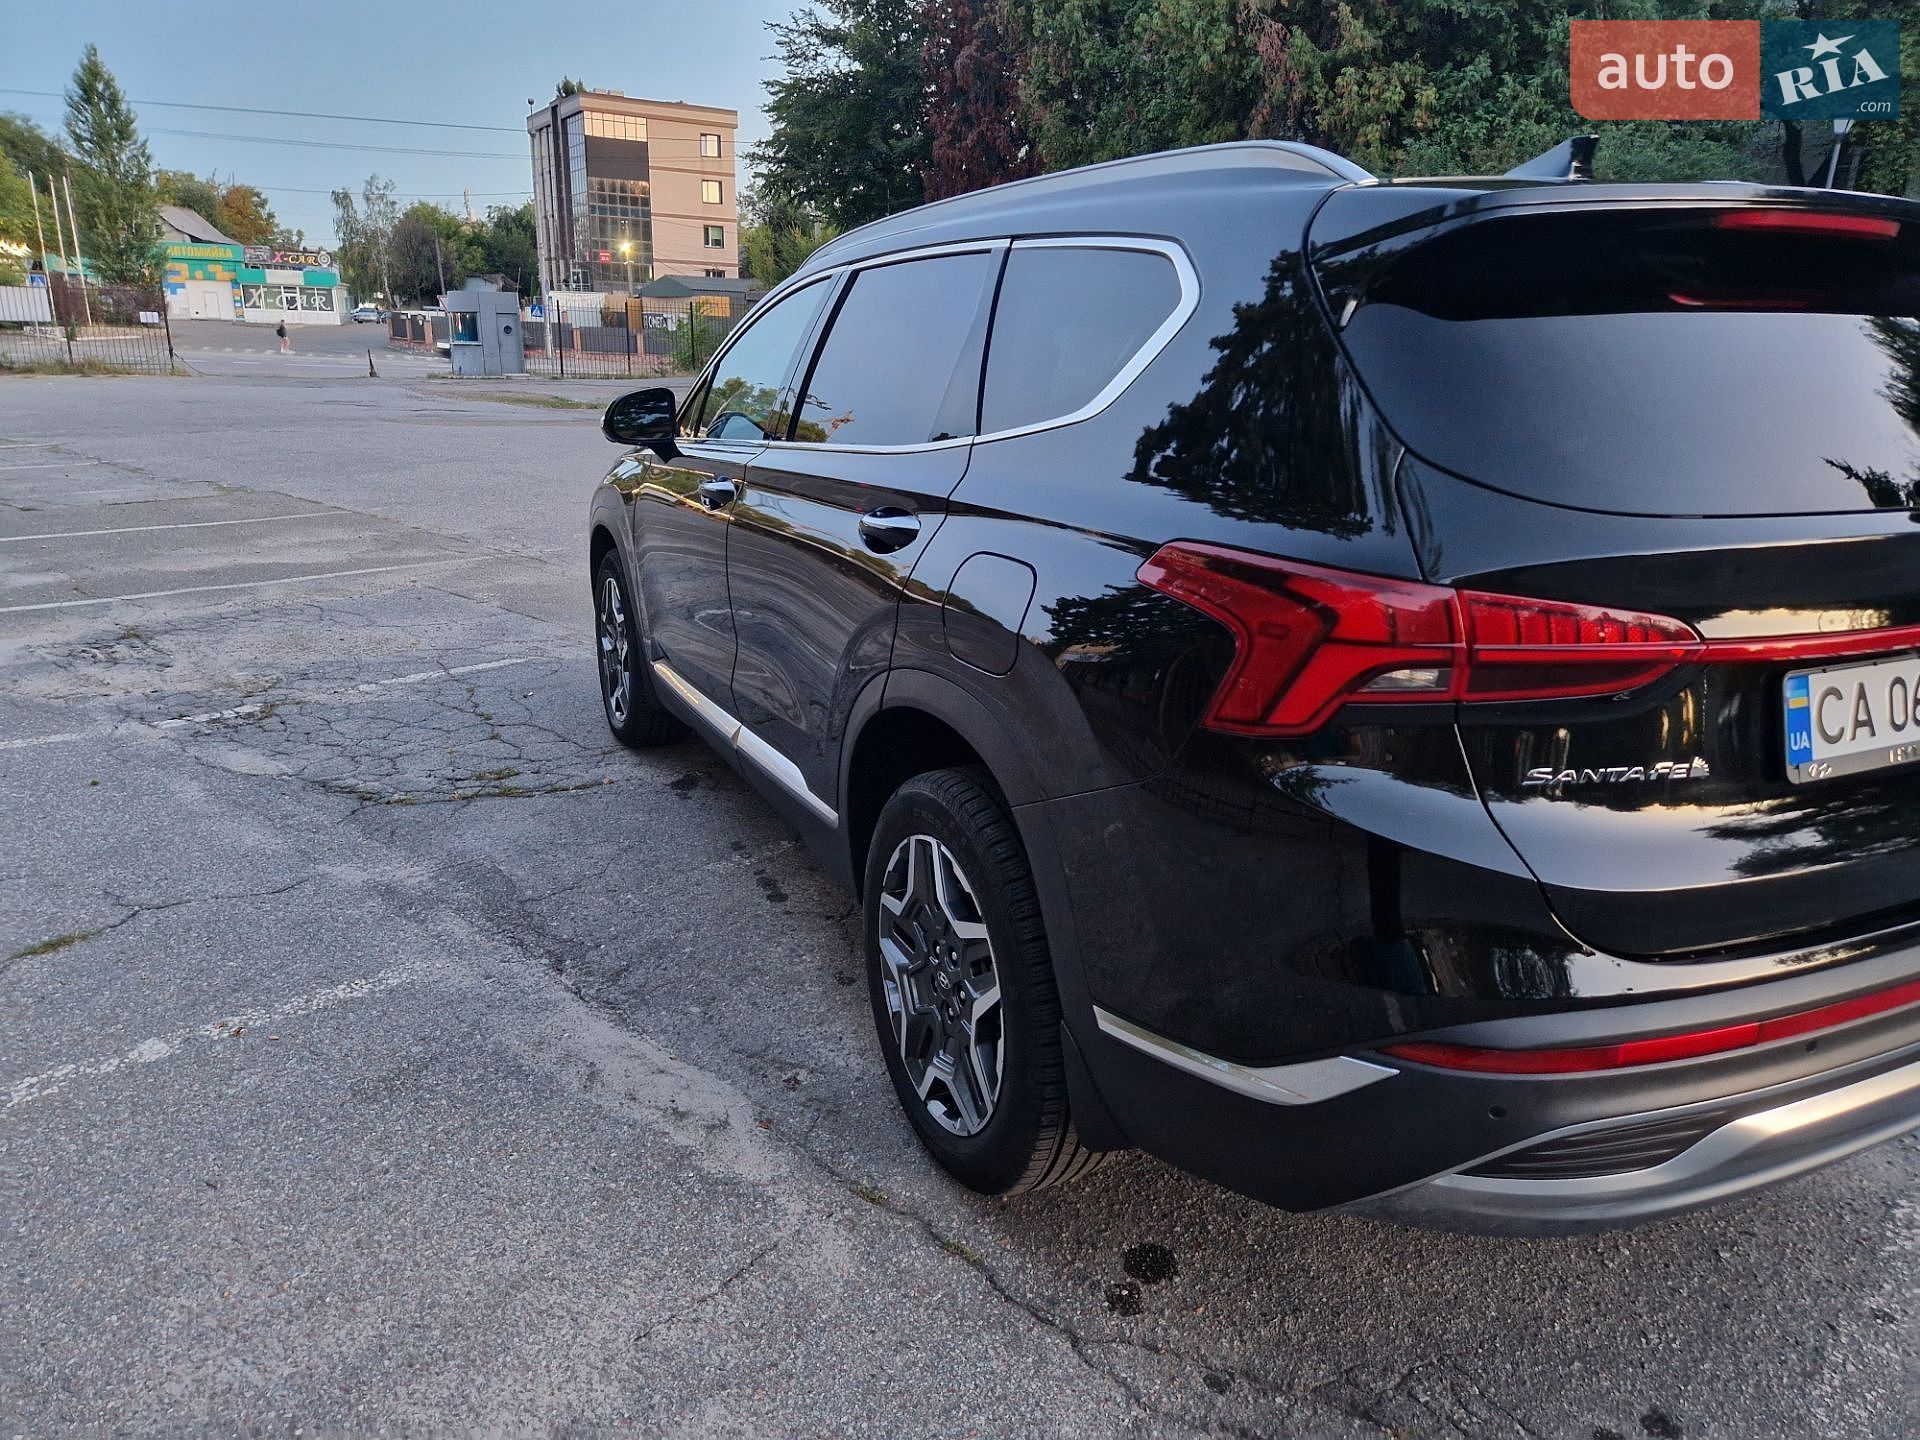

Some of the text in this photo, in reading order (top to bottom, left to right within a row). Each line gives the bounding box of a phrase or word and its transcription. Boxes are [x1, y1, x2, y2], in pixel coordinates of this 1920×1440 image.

[272, 250, 319, 265] X-CAR
[246, 287, 331, 310] X-CAR
[1815, 681, 1876, 744] CA
[1790, 731, 1810, 751] UA
[1522, 766, 1645, 786] SANTA
